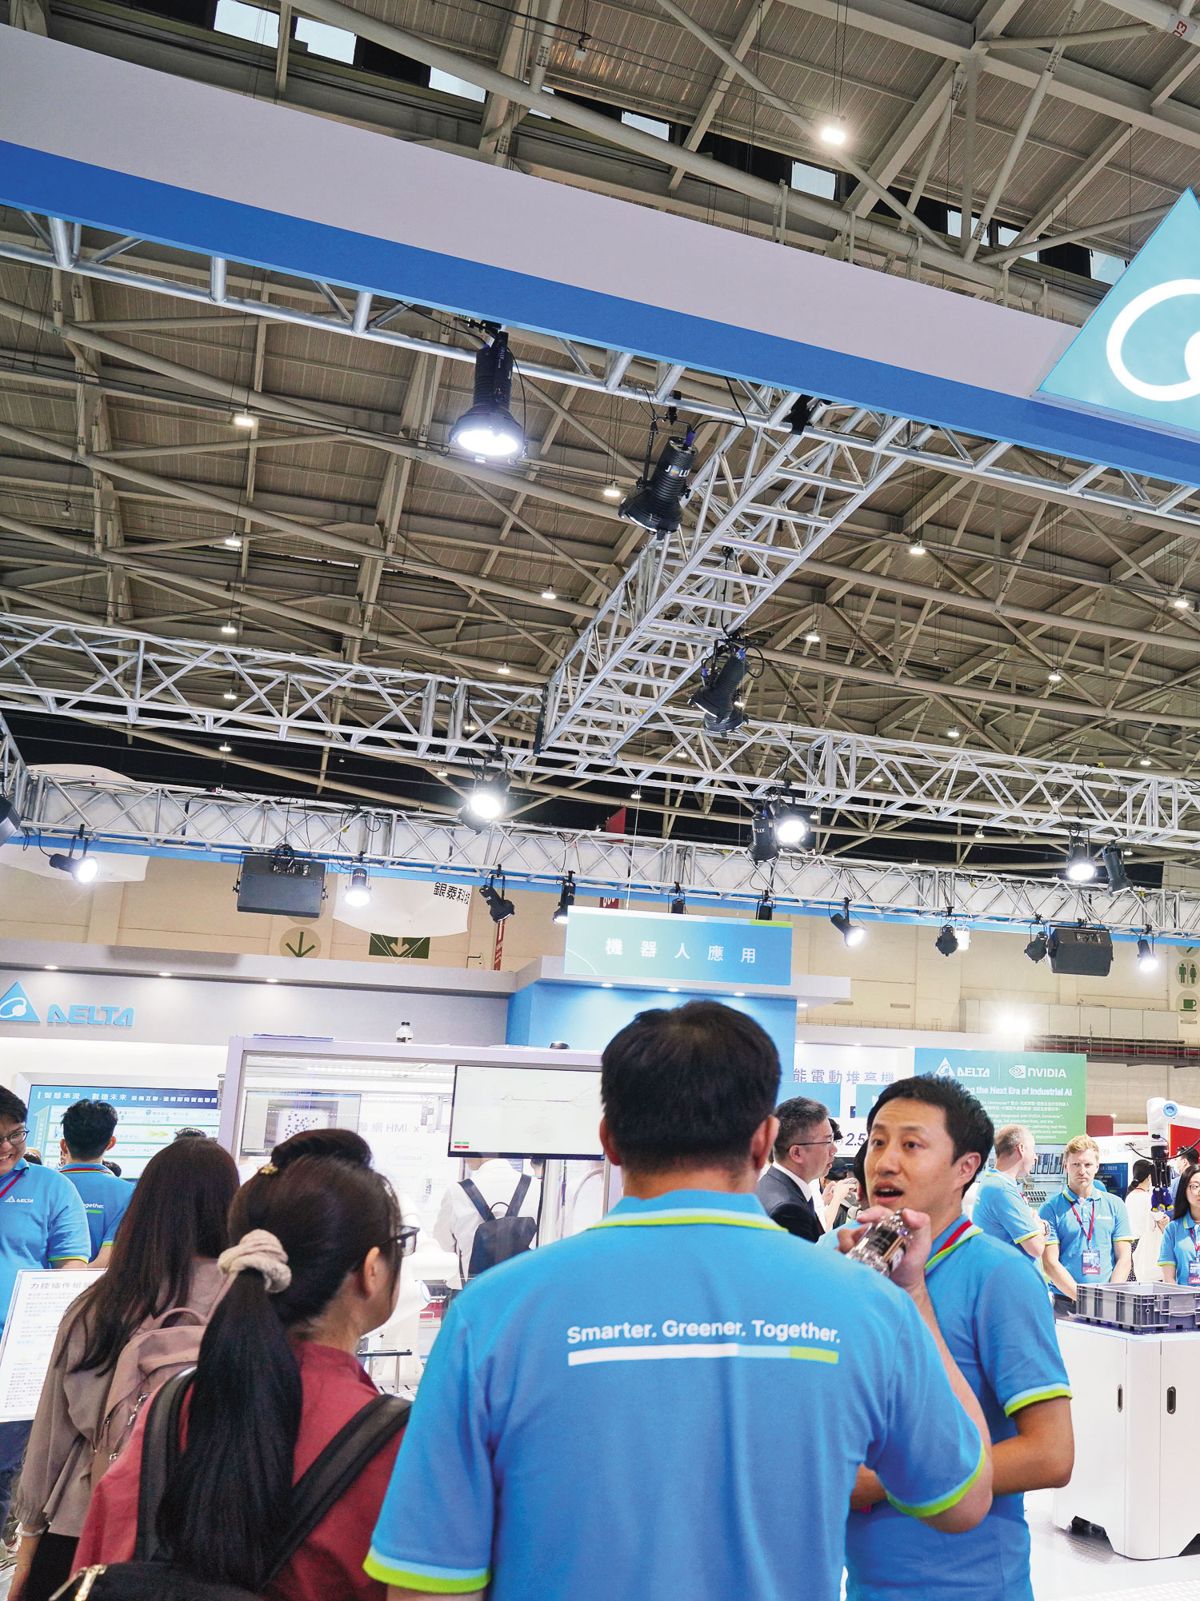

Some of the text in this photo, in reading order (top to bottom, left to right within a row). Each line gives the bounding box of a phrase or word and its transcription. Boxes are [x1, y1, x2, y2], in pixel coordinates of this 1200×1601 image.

[605, 937, 757, 964] 機器人應用
[47, 1003, 135, 1027] DELTA
[956, 1067, 991, 1078] DELTA
[1027, 1067, 1067, 1079] NVIDIA
[977, 1086, 988, 1095] the
[990, 1087, 1007, 1095] Next
[1008, 1087, 1021, 1096] Era
[1022, 1087, 1030, 1095] of
[1030, 1087, 1063, 1096] Industrial
[567, 1319, 841, 1344] Smarter. Greener. Together.
